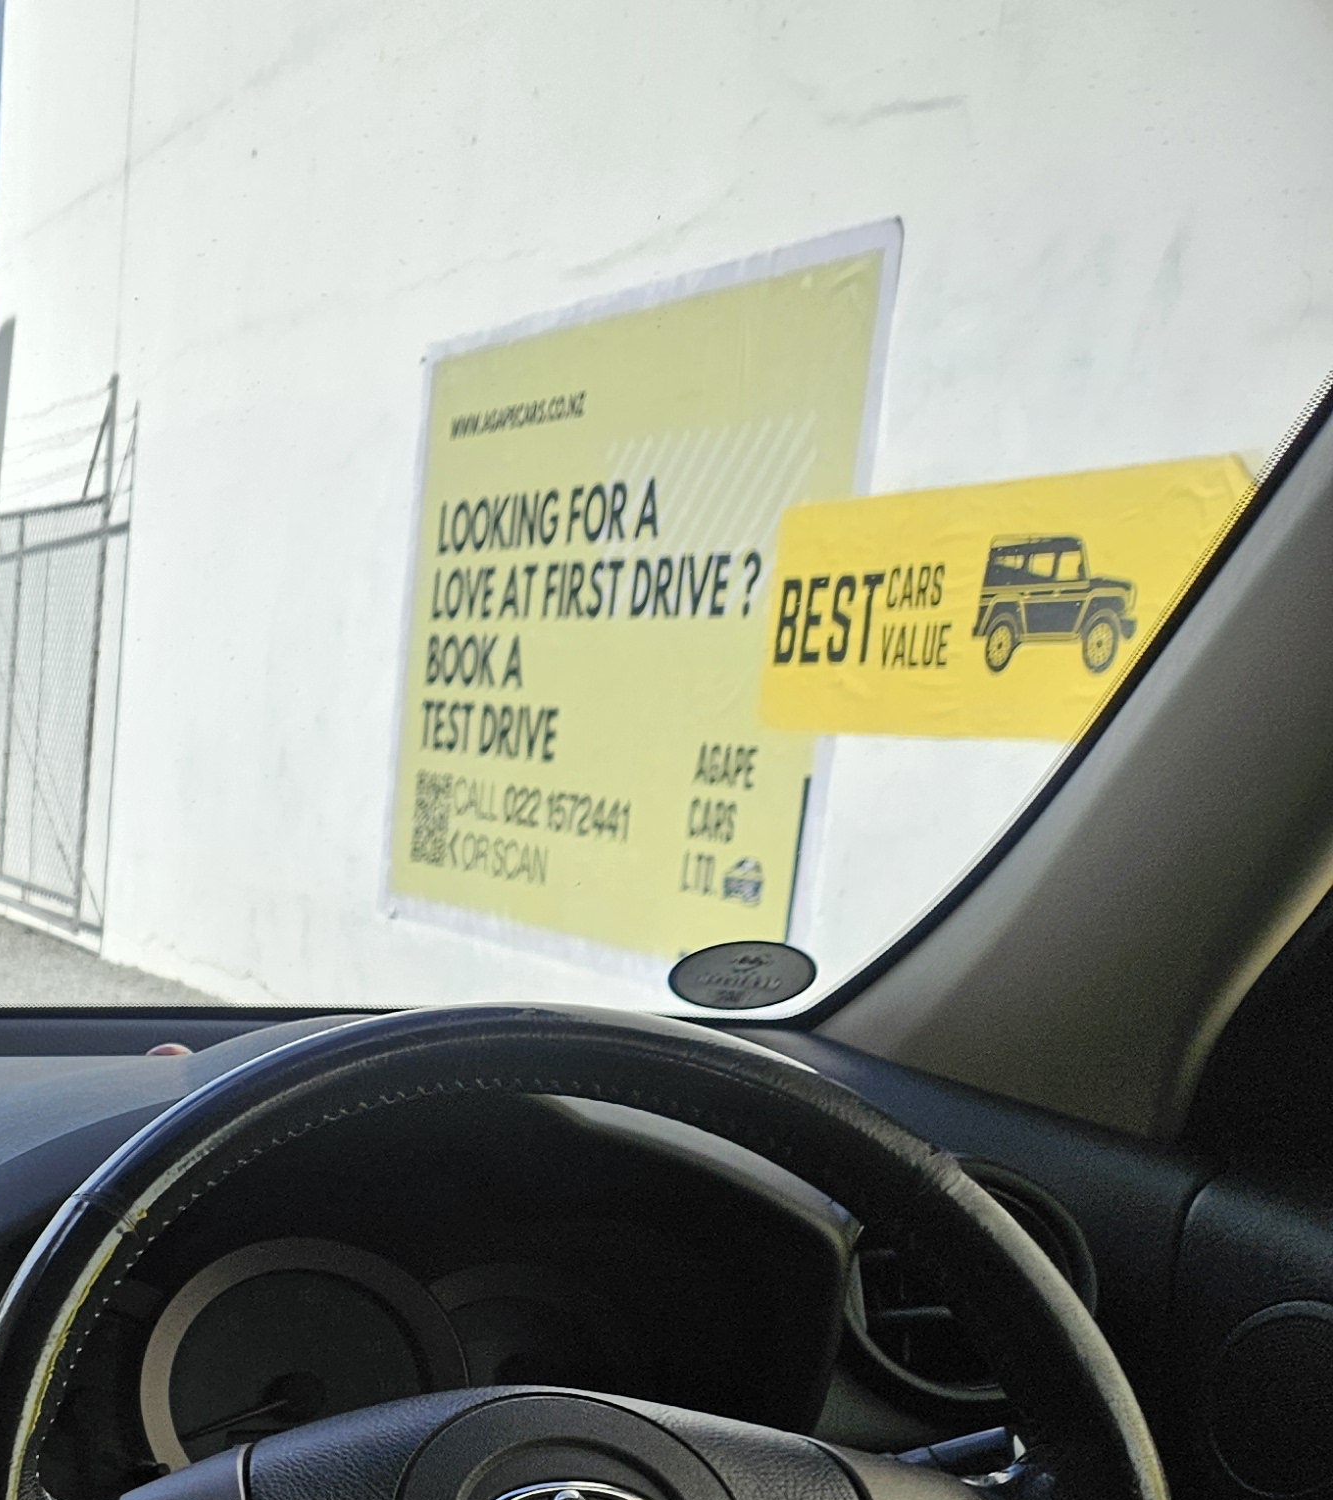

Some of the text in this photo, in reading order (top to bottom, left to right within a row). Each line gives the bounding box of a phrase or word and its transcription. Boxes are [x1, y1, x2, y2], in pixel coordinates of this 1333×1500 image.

[437, 475, 659, 556] LOOKING FOR A
[431, 548, 763, 621] LOVE AT FIRST DRIVE ?
[886, 562, 946, 610] CARS
[773, 571, 886, 666] BEST
[882, 620, 953, 671] VALUE
[424, 633, 524, 690] BOOK A
[420, 698, 561, 764] TEST DRIVE
[693, 742, 758, 791] AGAPE
[453, 775, 631, 843] CALL 022 1572441
[686, 795, 738, 844] CARS
[490, 836, 549, 886] SCAN
